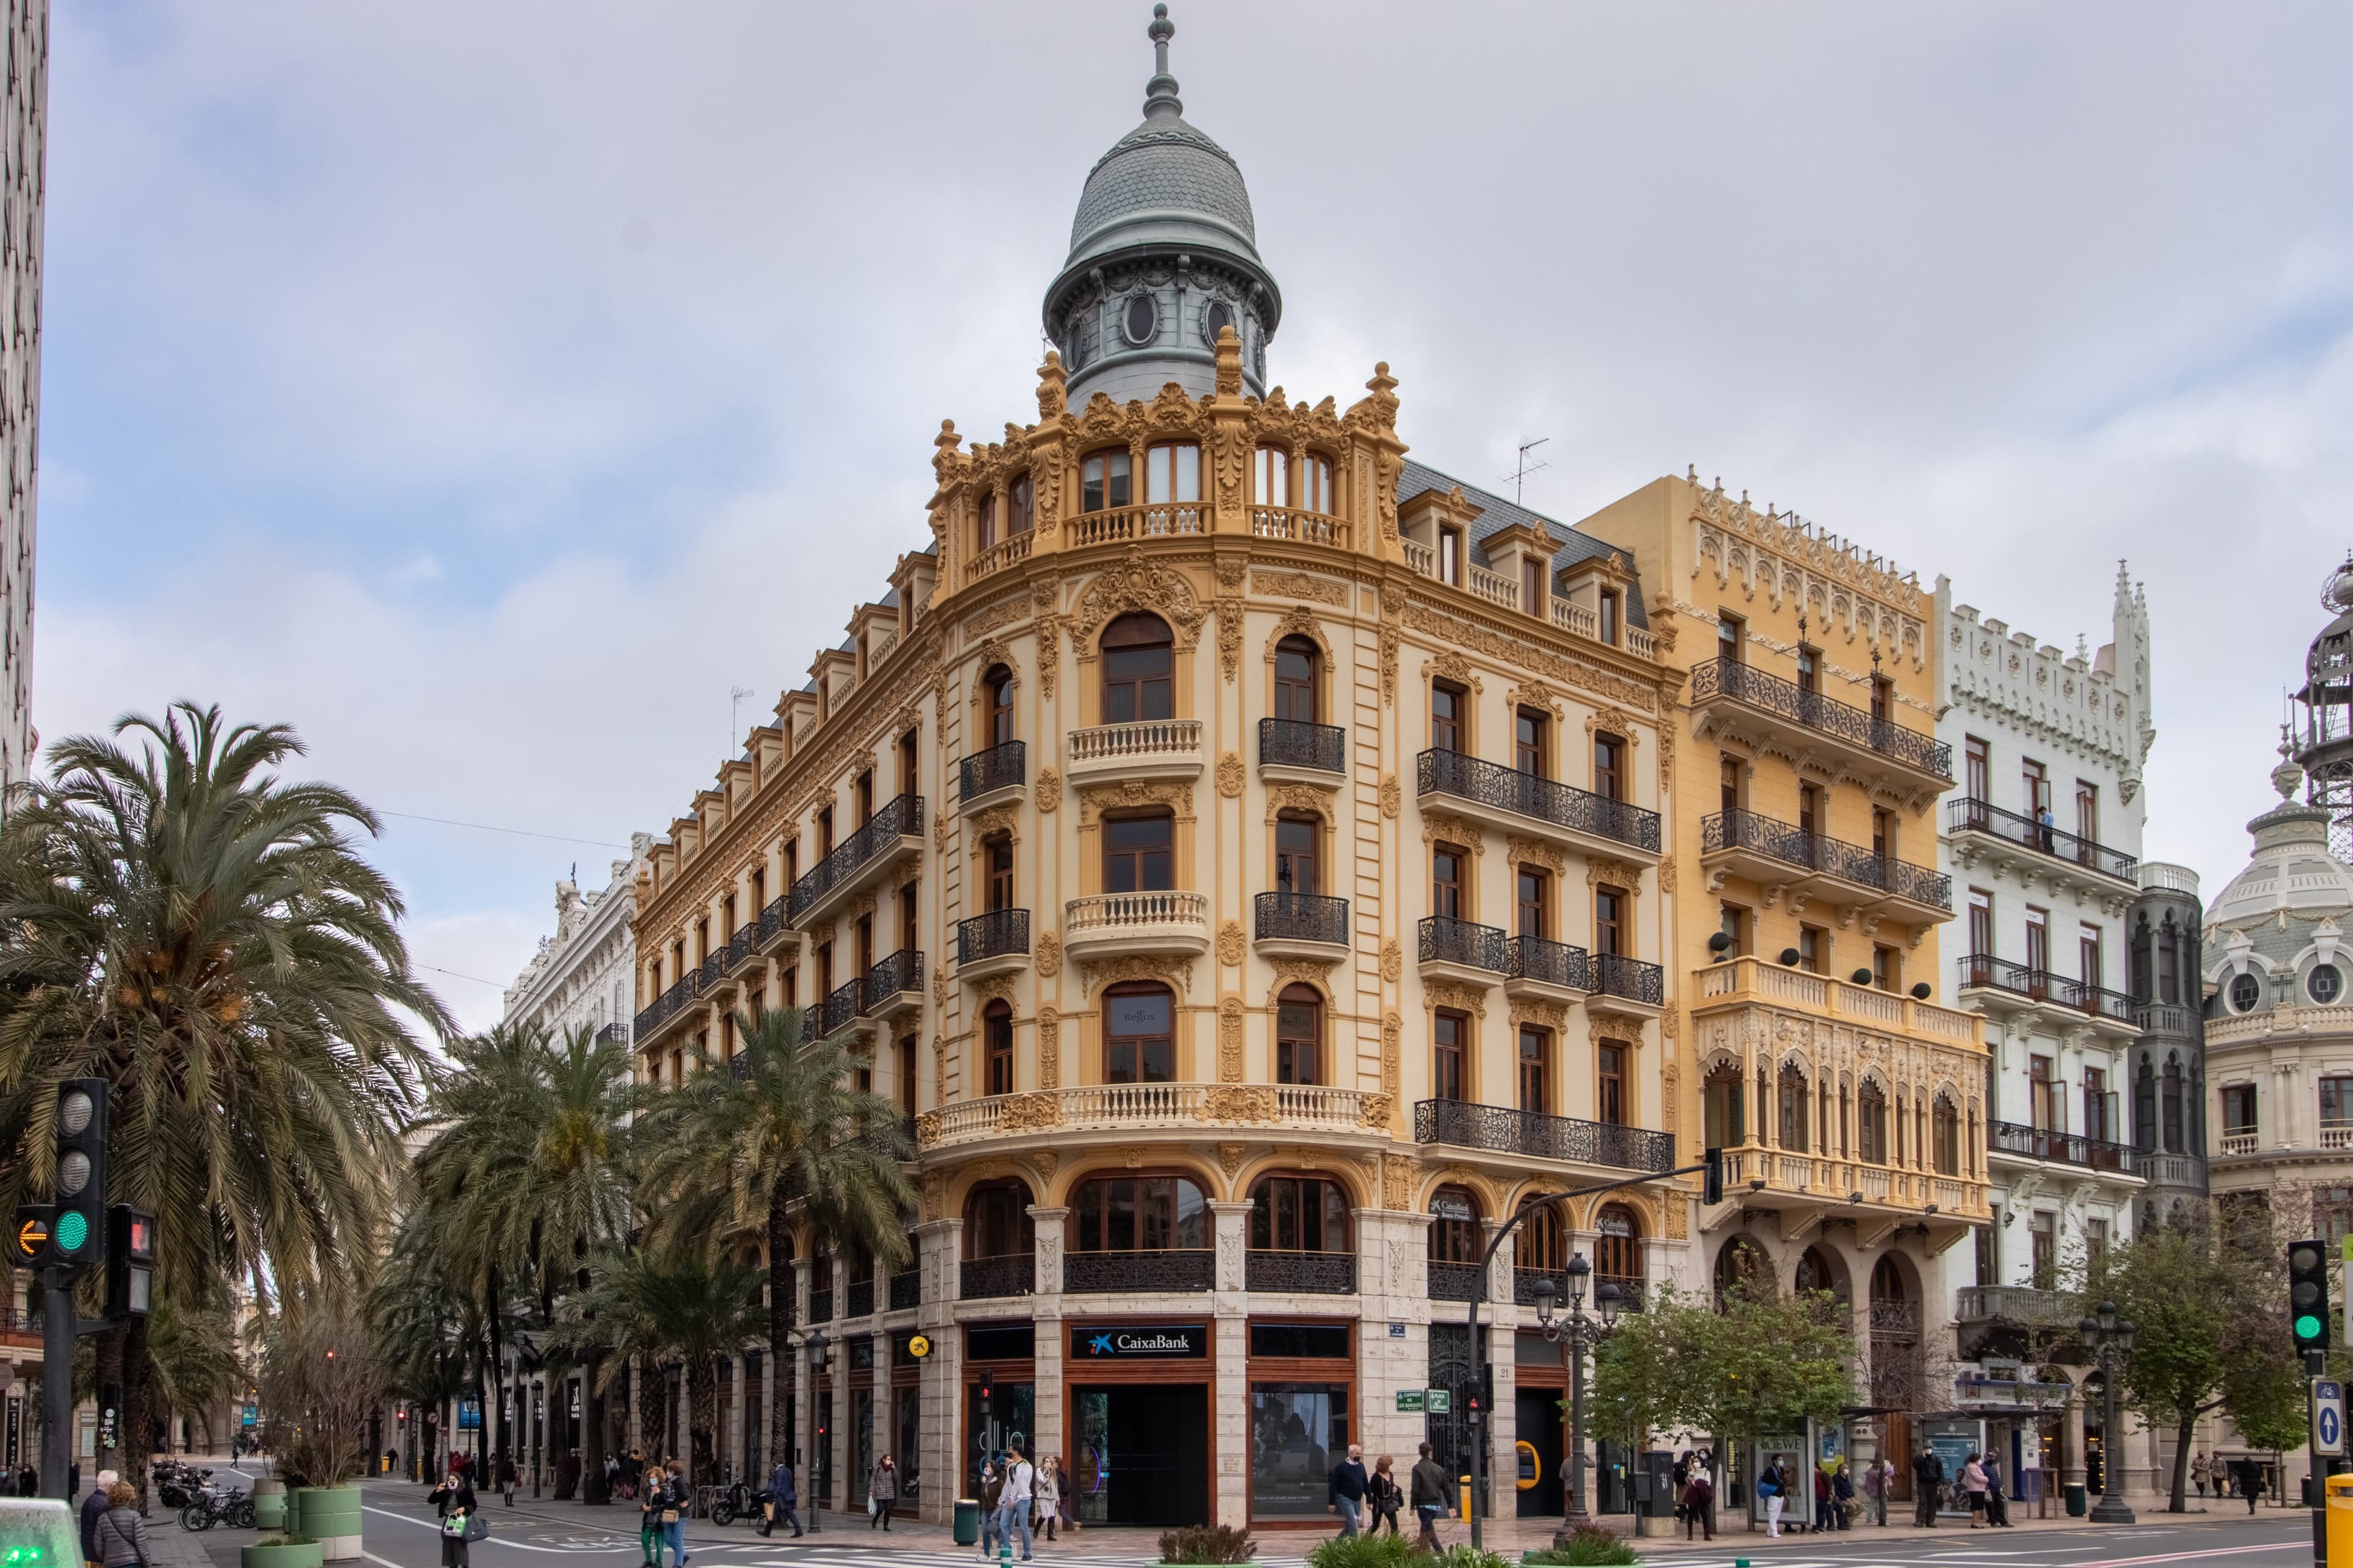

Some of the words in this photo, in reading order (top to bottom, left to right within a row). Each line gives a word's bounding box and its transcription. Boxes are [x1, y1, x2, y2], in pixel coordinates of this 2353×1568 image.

[1124, 1013, 1156, 1023] Regus
[1281, 1017, 1310, 1029] Regus
[1441, 1201, 1469, 1211] CaixaBank
[1118, 1334, 1189, 1349] CaixaBank
[1501, 1368, 1509, 1377] 21
